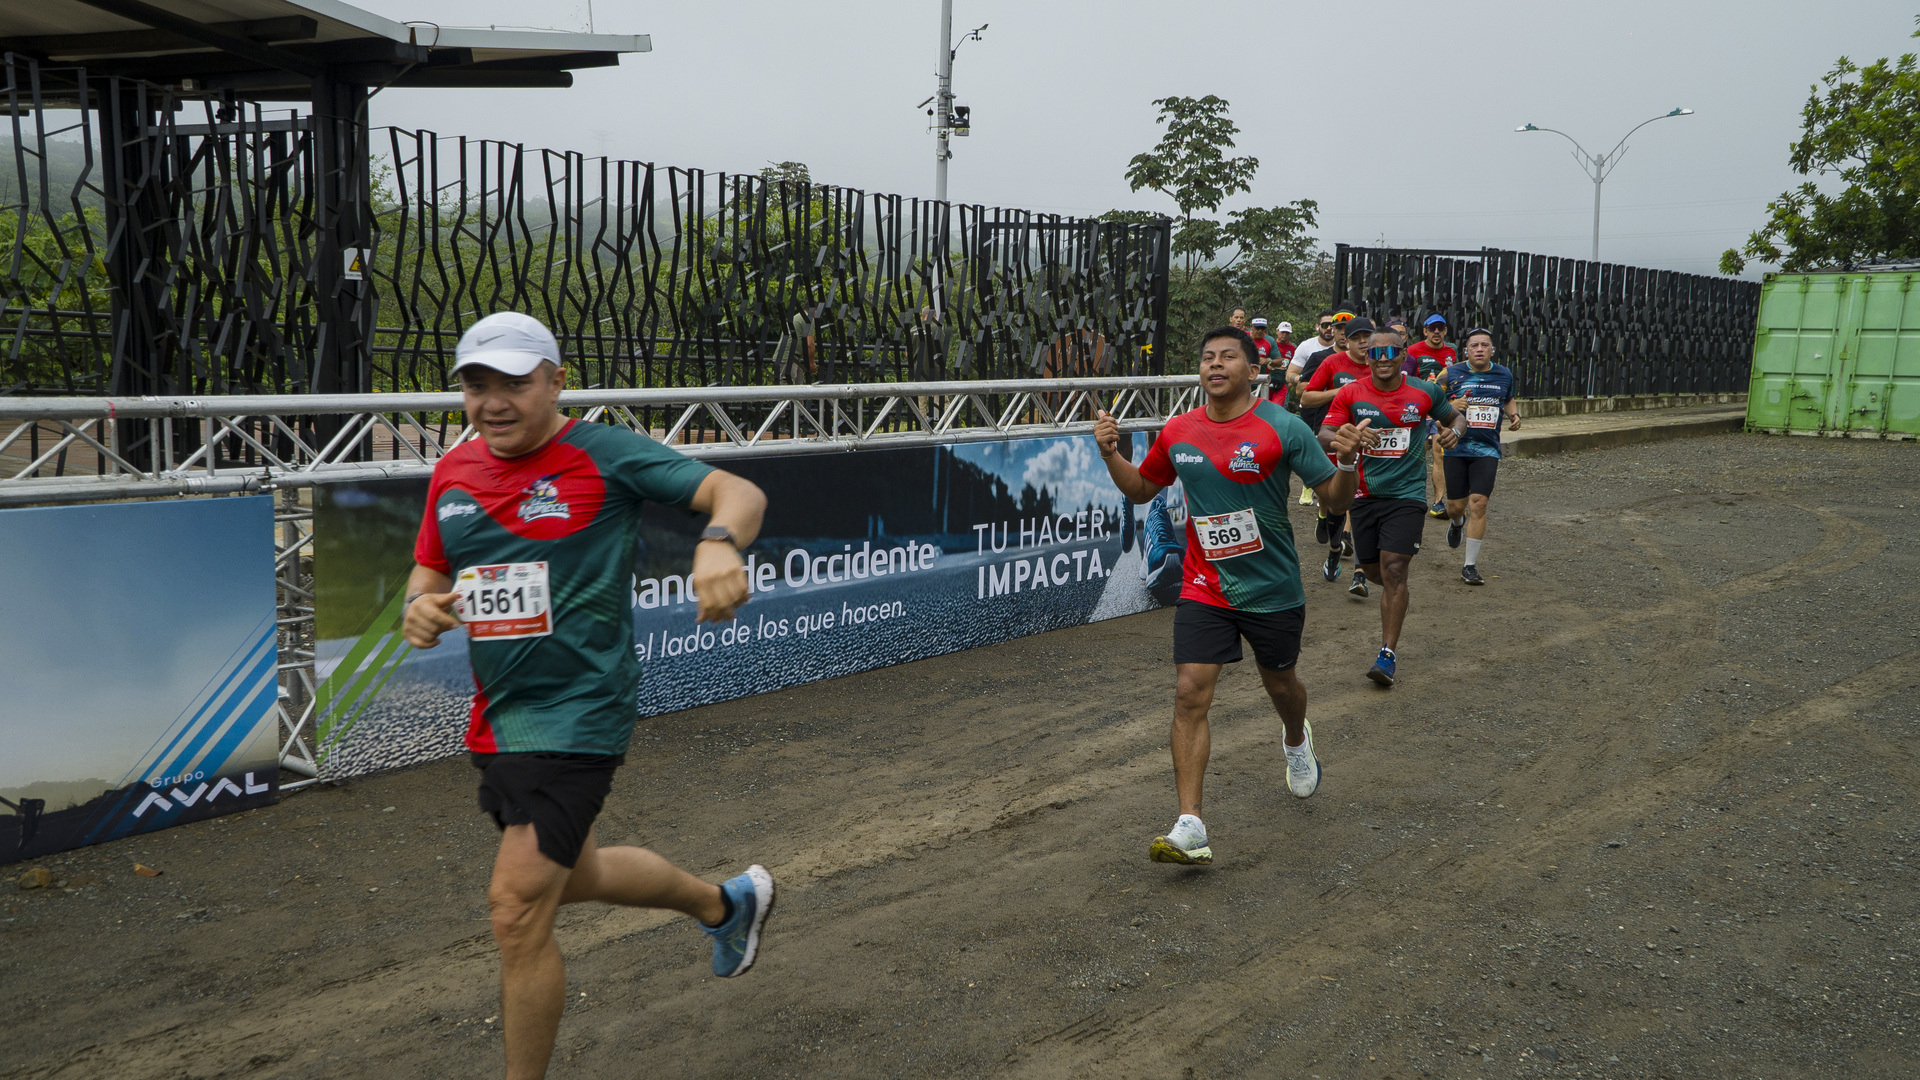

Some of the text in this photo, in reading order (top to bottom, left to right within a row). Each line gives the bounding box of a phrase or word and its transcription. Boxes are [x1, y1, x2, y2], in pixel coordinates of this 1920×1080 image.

[1475, 412, 1492, 422] 193
[973, 510, 1111, 556] TU HACER,
[1208, 527, 1242, 546] 569
[631, 572, 698, 610] anc
[784, 540, 935, 588] Occidente
[978, 548, 1111, 599] IMPACTA.
[466, 586, 525, 616] 1561
[661, 624, 715, 658] lado
[721, 618, 750, 646] de
[758, 614, 789, 640] los
[795, 611, 835, 639] que
[841, 601, 907, 626] hacen.
[132, 772, 269, 818] AVAL
[150, 770, 205, 789] Grupo
